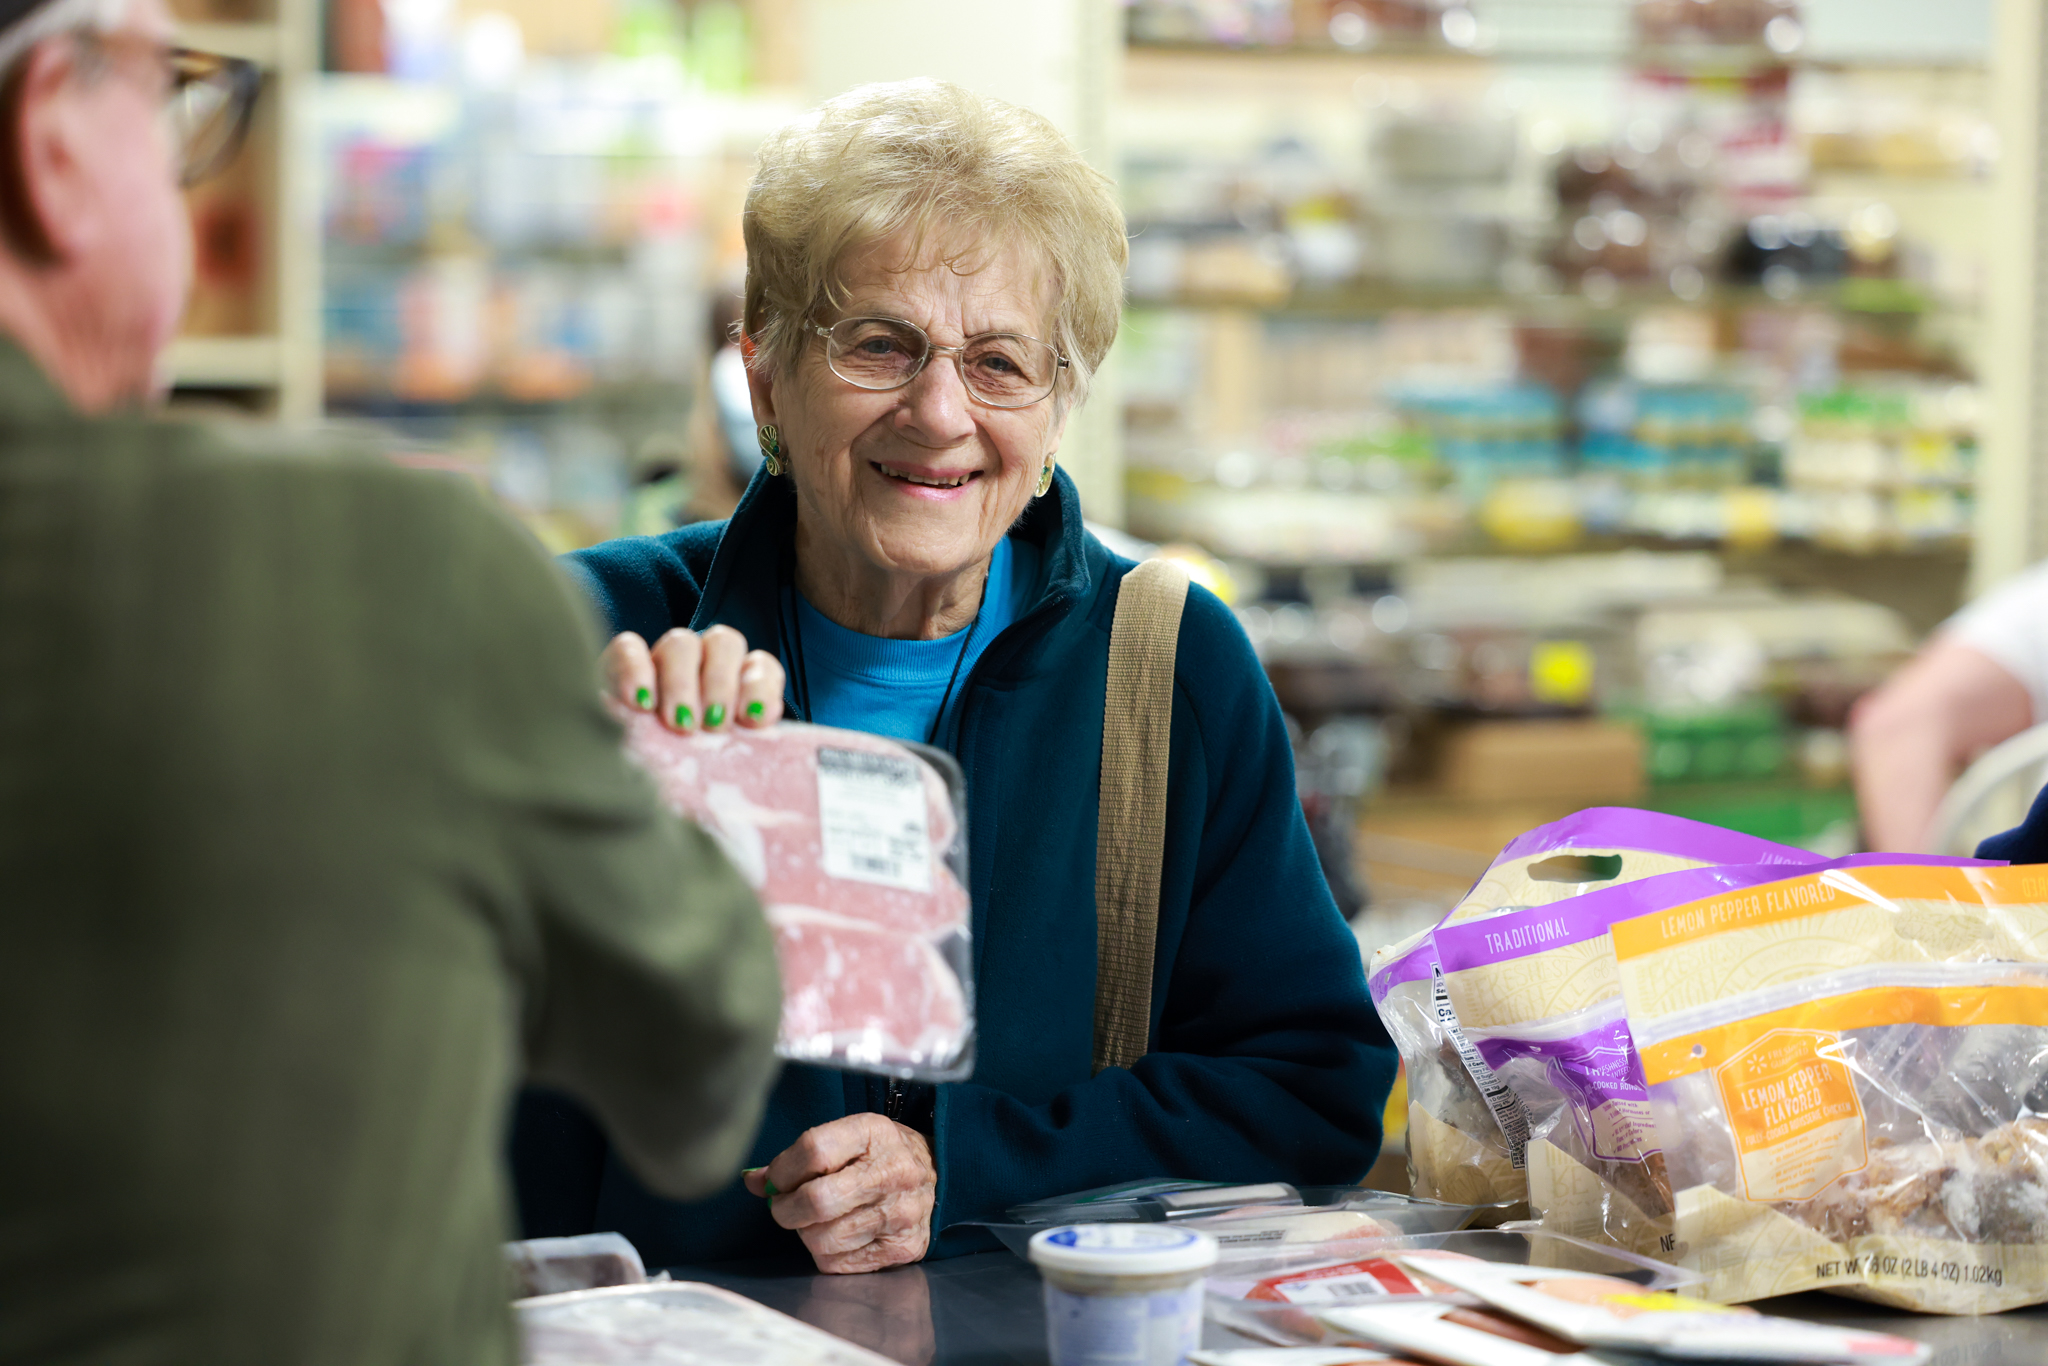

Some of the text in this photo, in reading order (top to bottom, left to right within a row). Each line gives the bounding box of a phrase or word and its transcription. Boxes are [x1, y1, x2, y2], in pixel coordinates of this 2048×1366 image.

[1661, 881, 1836, 939] LEMON PEPPER FLAVORED
[1485, 917, 1570, 954] TRADITIONAL
[1741, 1063, 1833, 1112] LEMON PEPPER
[1763, 1087, 1822, 1127] FLAVORED
[1816, 1260, 1842, 1278] NET
[1883, 1256, 1898, 1275] OZ
[1901, 1258, 1912, 1279] (2
[1914, 1260, 1928, 1278] LB
[1931, 1263, 1938, 1278] 4
[1941, 1262, 1960, 1285] OZ)
[1964, 1265, 2002, 1286] 1.02kg
